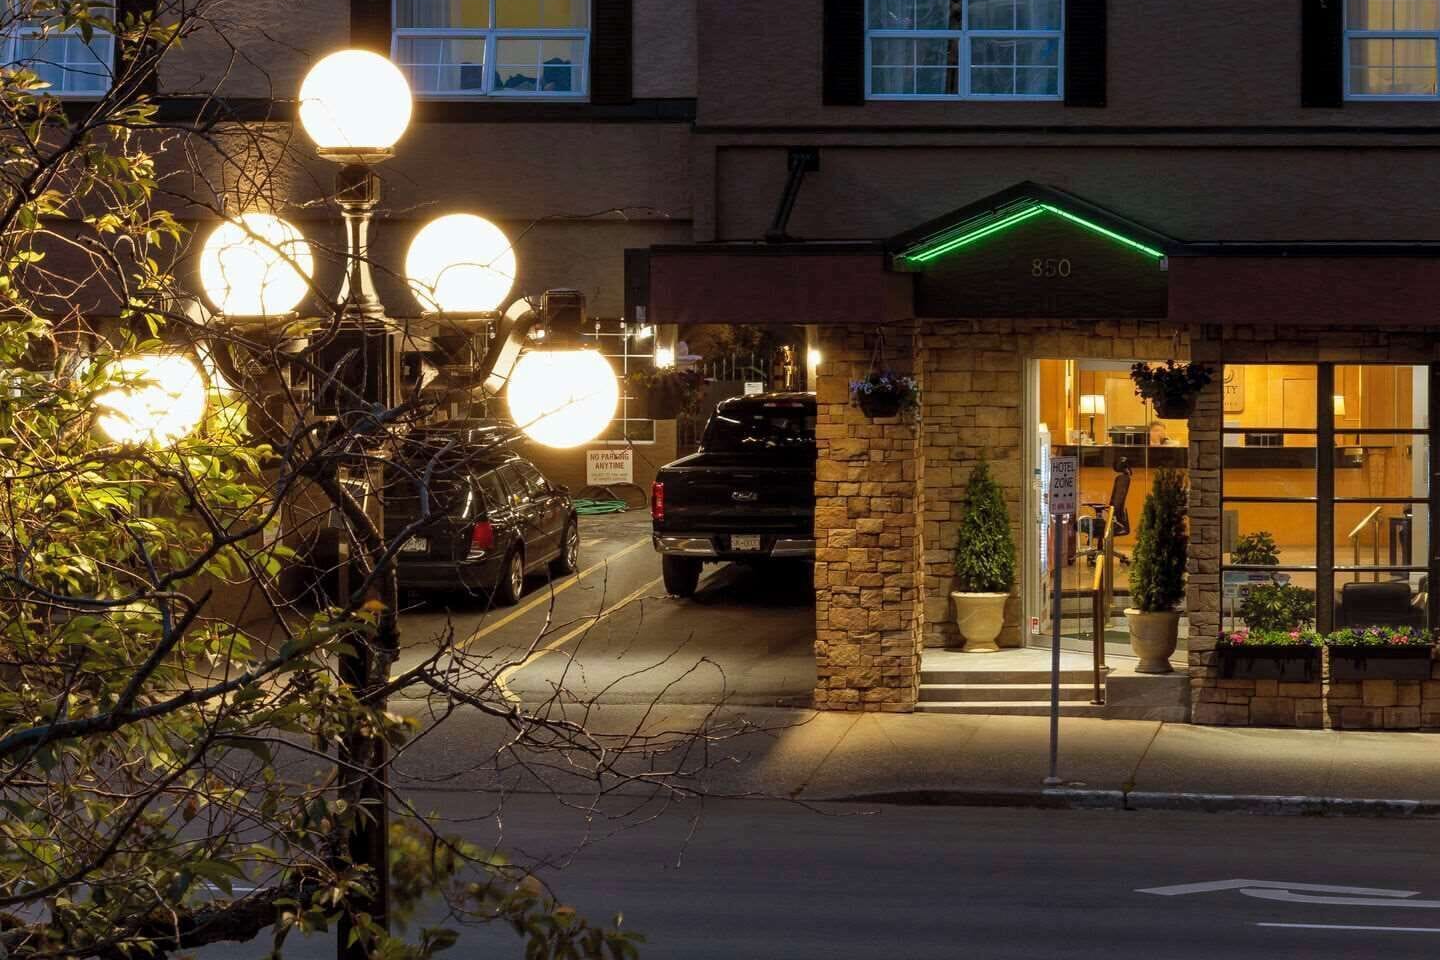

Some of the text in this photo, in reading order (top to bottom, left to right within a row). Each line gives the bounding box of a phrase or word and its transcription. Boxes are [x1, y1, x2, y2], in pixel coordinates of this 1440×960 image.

[1031, 258, 1071, 278] 850
[590, 453, 630, 461] NO PARKING
[595, 461, 625, 470] ANYTIME
[1052, 461, 1074, 473] HOTEL
[1054, 477, 1073, 488] ZONE
